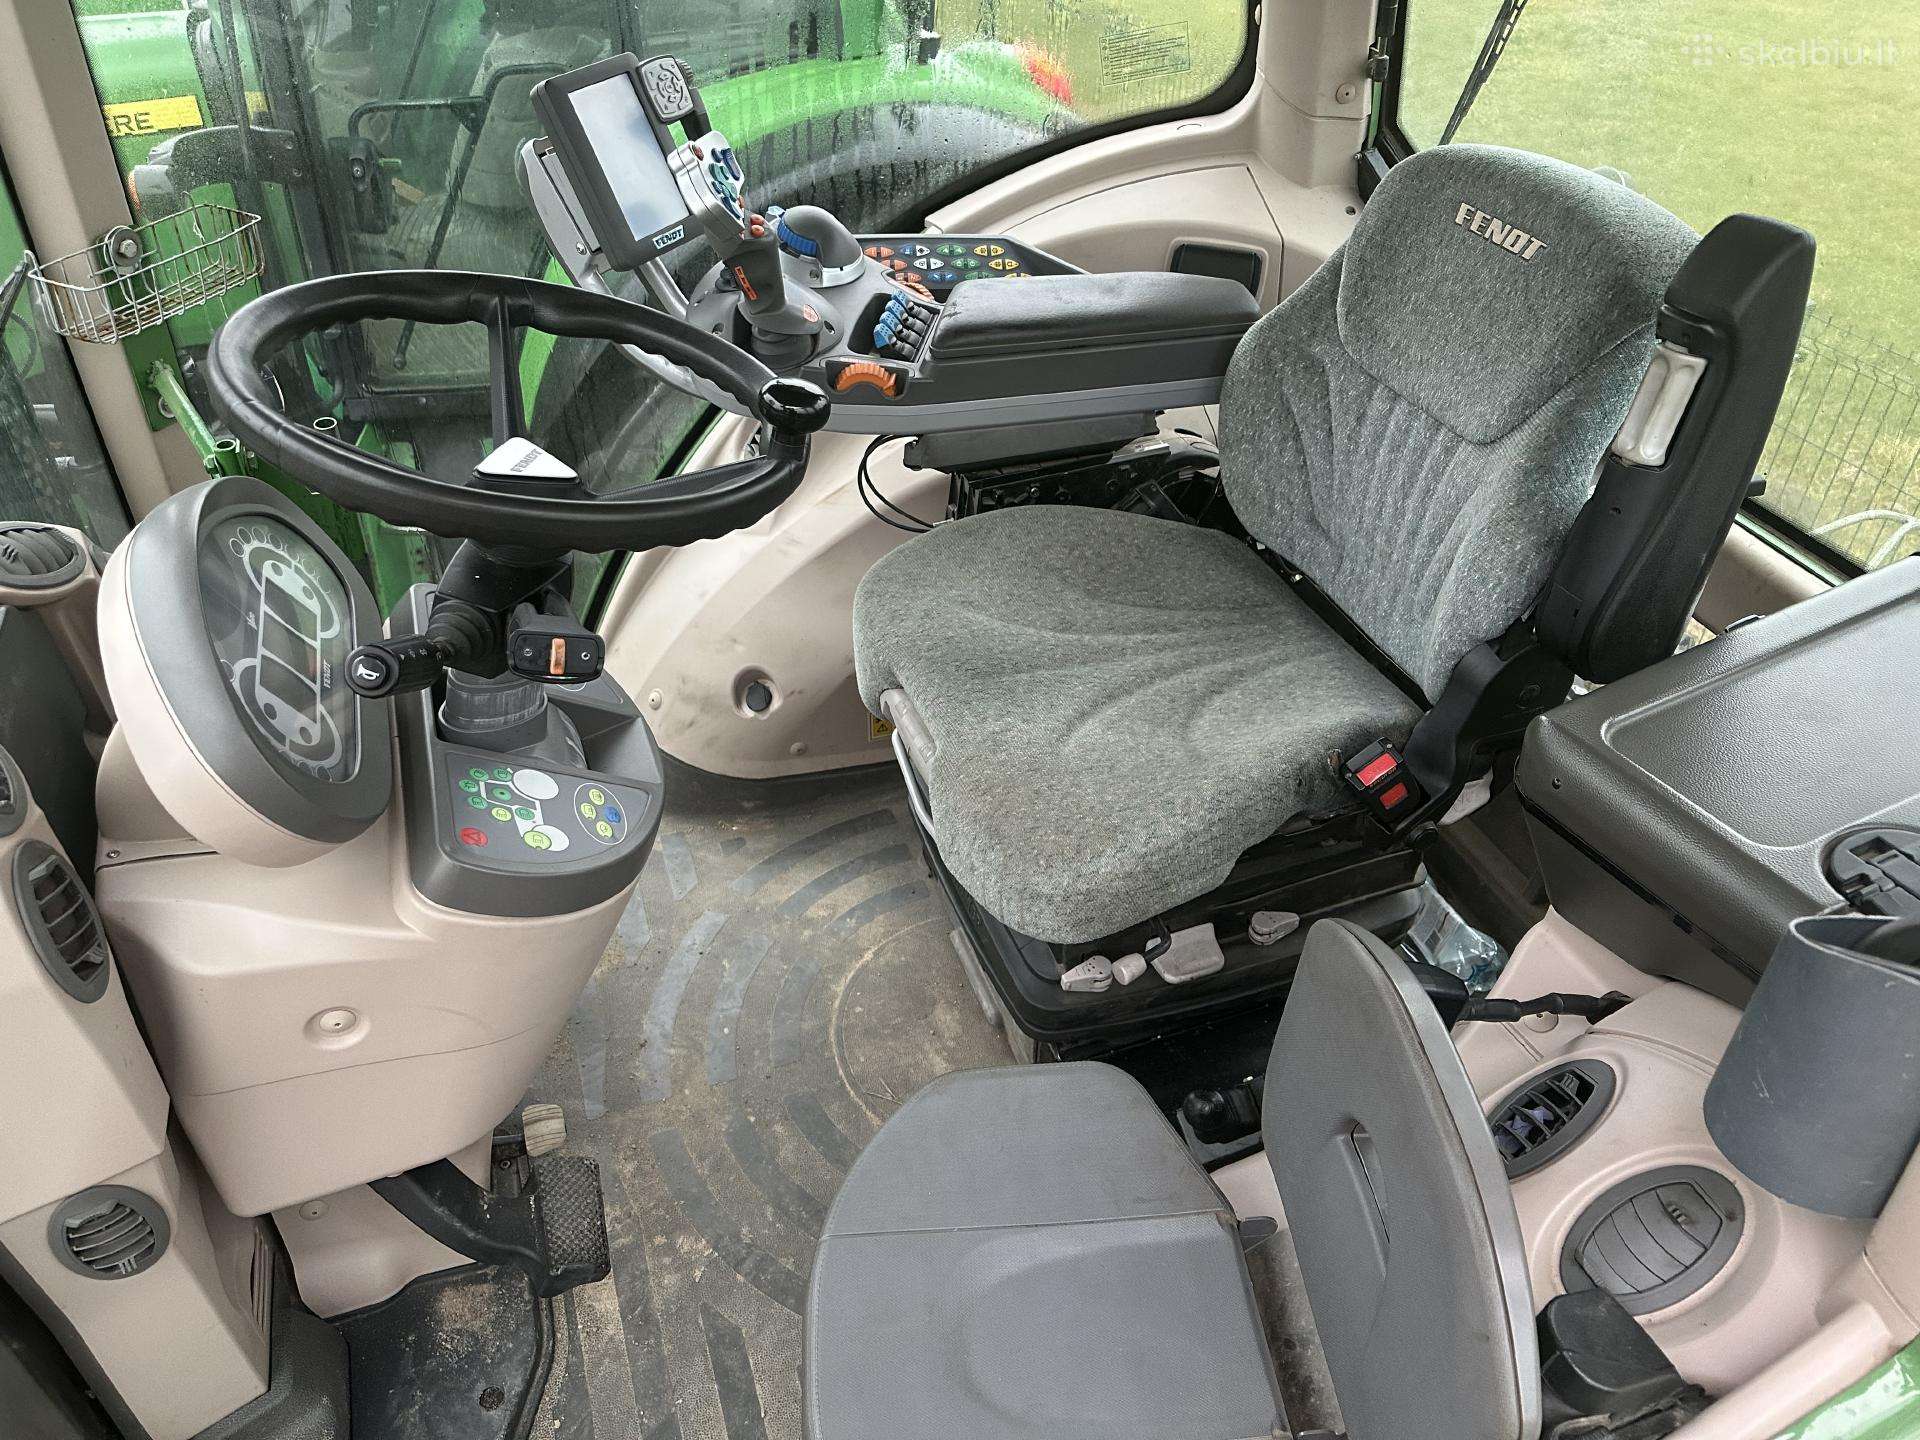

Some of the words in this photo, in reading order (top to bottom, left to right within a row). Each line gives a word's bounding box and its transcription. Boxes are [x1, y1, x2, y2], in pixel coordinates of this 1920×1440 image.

[111, 111, 154, 135] RE
[655, 228, 683, 247] FENDT
[1455, 202, 1548, 260] FENDT
